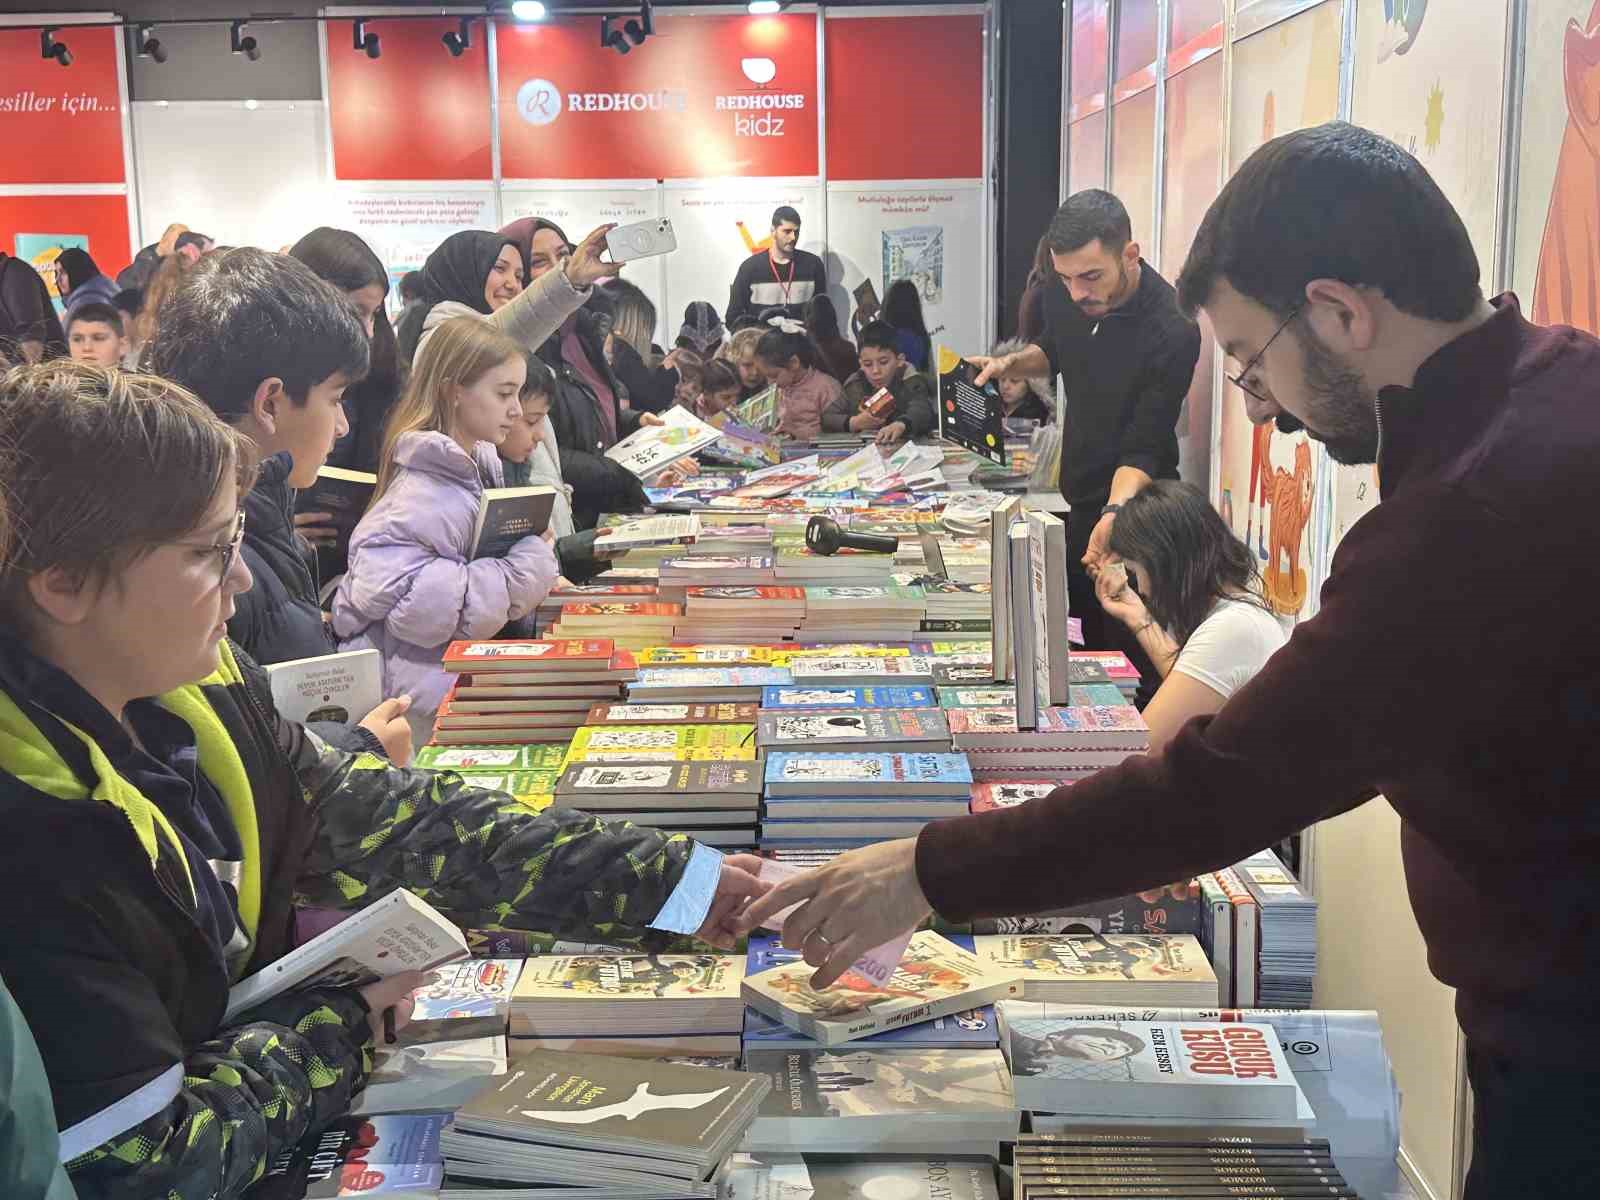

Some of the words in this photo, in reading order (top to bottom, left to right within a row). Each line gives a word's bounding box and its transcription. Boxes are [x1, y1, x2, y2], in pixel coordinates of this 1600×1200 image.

[61, 91, 116, 116] için...
[715, 94, 805, 110] REDHOUSE
[735, 112, 785, 137] kidz
[1150, 1028, 1165, 1046] KEN
[1155, 1047, 1174, 1074] KESEY
[1180, 1029, 1234, 1075] KUŞU
[1221, 1027, 1278, 1078] GUGUK
